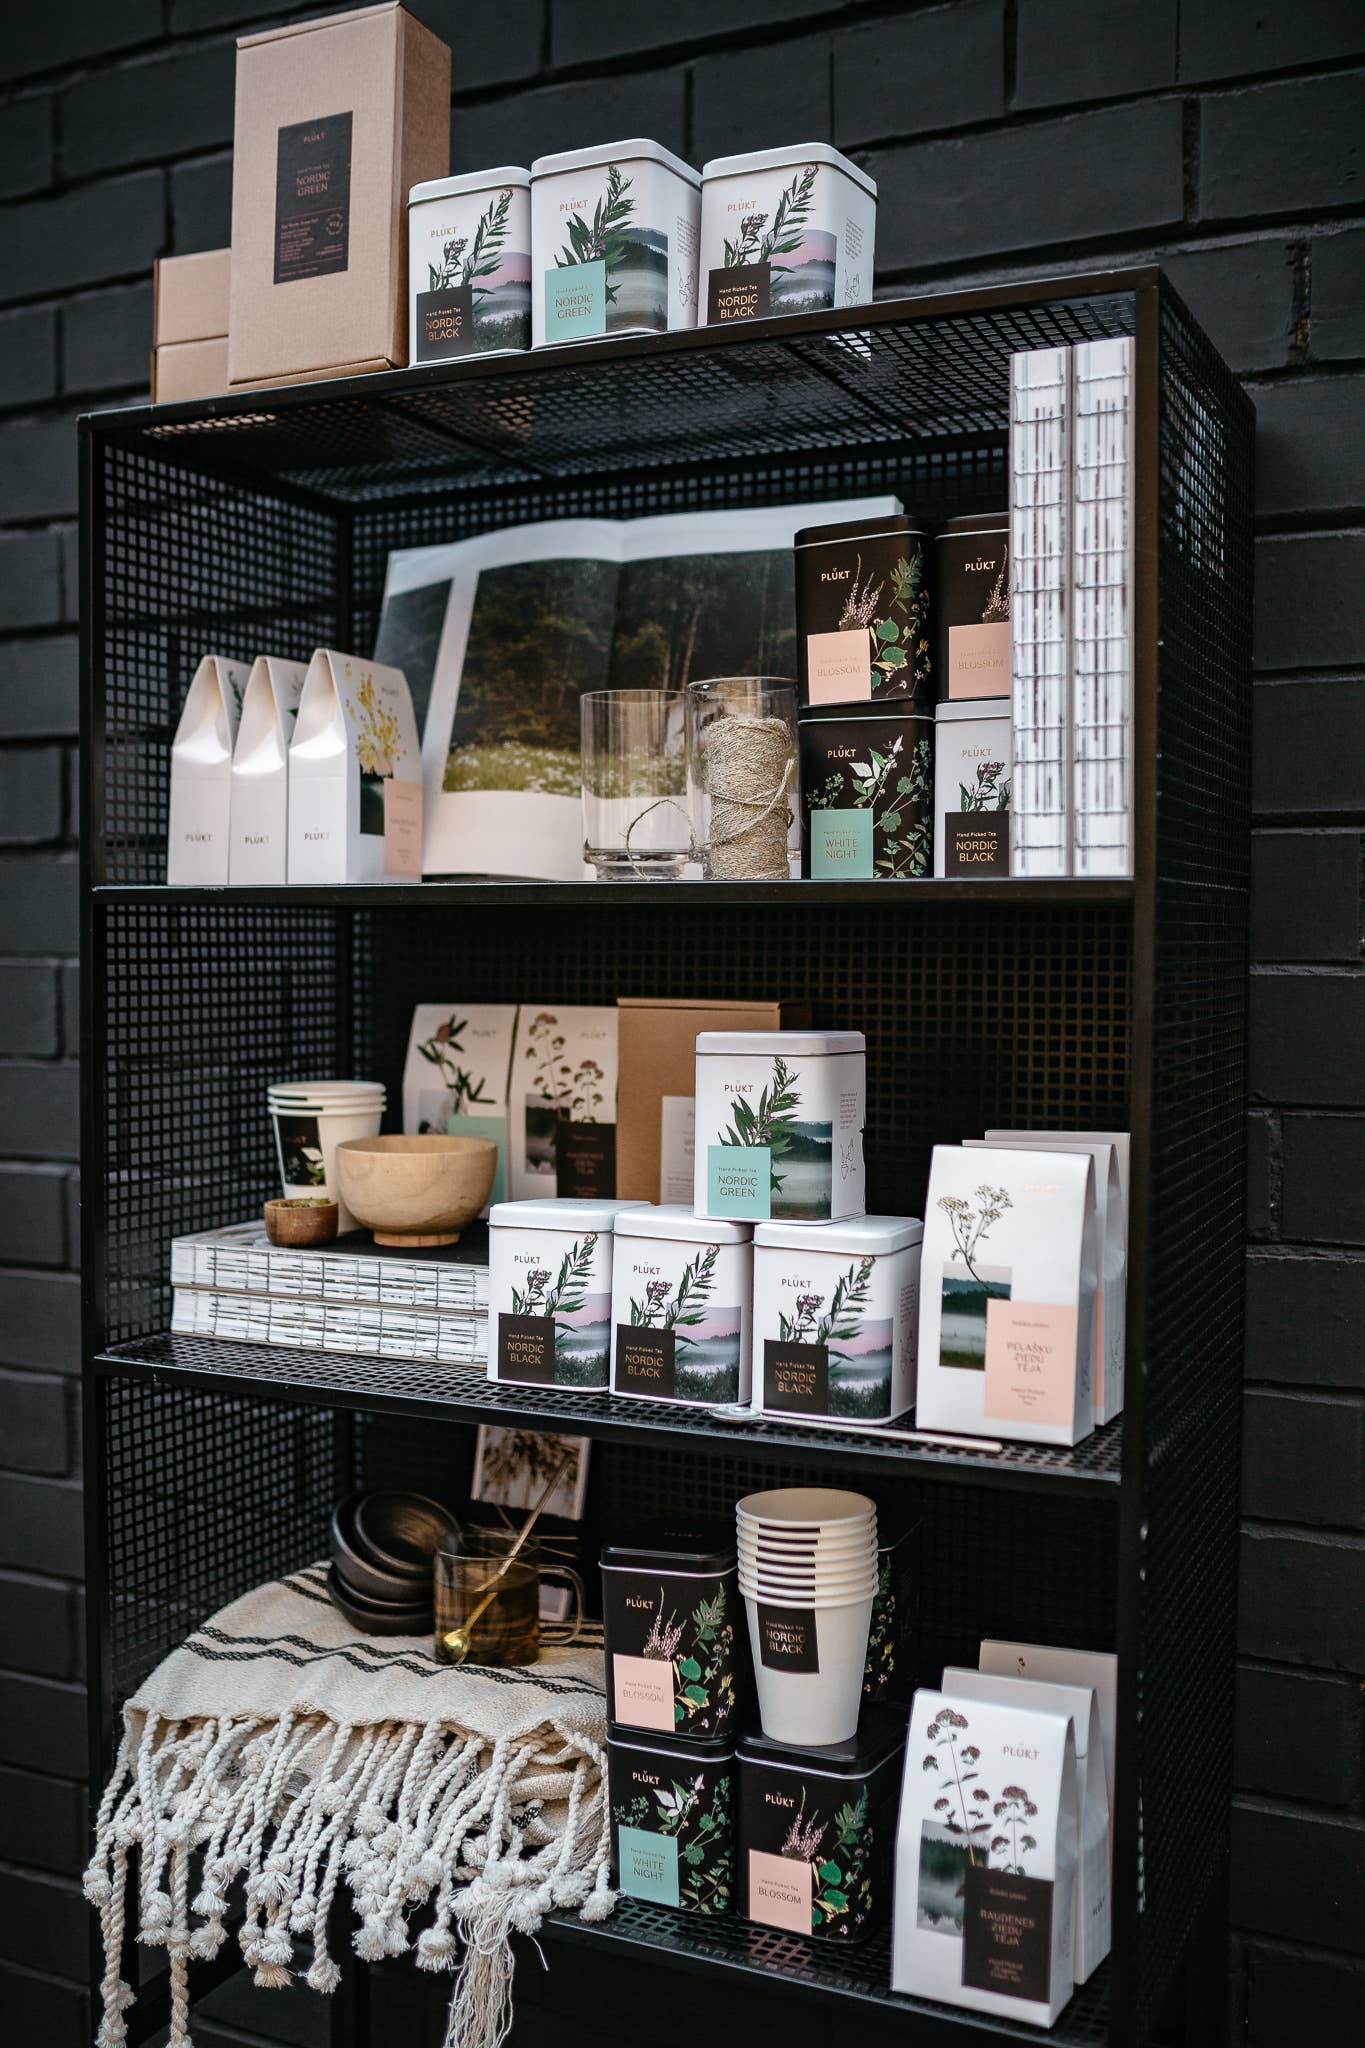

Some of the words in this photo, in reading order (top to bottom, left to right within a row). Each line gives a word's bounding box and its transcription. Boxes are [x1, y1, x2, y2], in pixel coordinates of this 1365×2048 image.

[296, 171, 331, 186] NORDIC
[297, 183, 328, 197] GREEN
[555, 293, 594, 309] NORDIC
[718, 293, 759, 307] NORDIC
[556, 305, 592, 320] GREEN
[720, 305, 755, 319] BLACK
[425, 316, 463, 331] NORDIC
[428, 328, 460, 342] BLACK
[817, 665, 861, 677] BLOSSOM
[958, 659, 1005, 670] BLOSSOM
[825, 838, 858, 848] WHITE
[956, 840, 998, 851] NORDIC
[824, 849, 857, 859] NIGHT
[959, 852, 994, 862] BLACK
[718, 1175, 759, 1187] NORDIC
[719, 1186, 756, 1198] GREEN
[507, 1342, 545, 1354] NORDIC
[510, 1353, 541, 1365] BLACK
[625, 1354, 664, 1367] NORDIC
[627, 1365, 660, 1378] BLACK
[775, 1370, 817, 1384] NORDIC
[777, 1382, 813, 1395] BLACK
[766, 1630, 805, 1643] NORDIC
[769, 1641, 804, 1654] BLACK
[623, 1689, 664, 1704] BLOSSOM
[633, 1856, 665, 1871] WHITE
[633, 1868, 664, 1881] NIGHT
[758, 1886, 802, 1904] BLOSSOM
